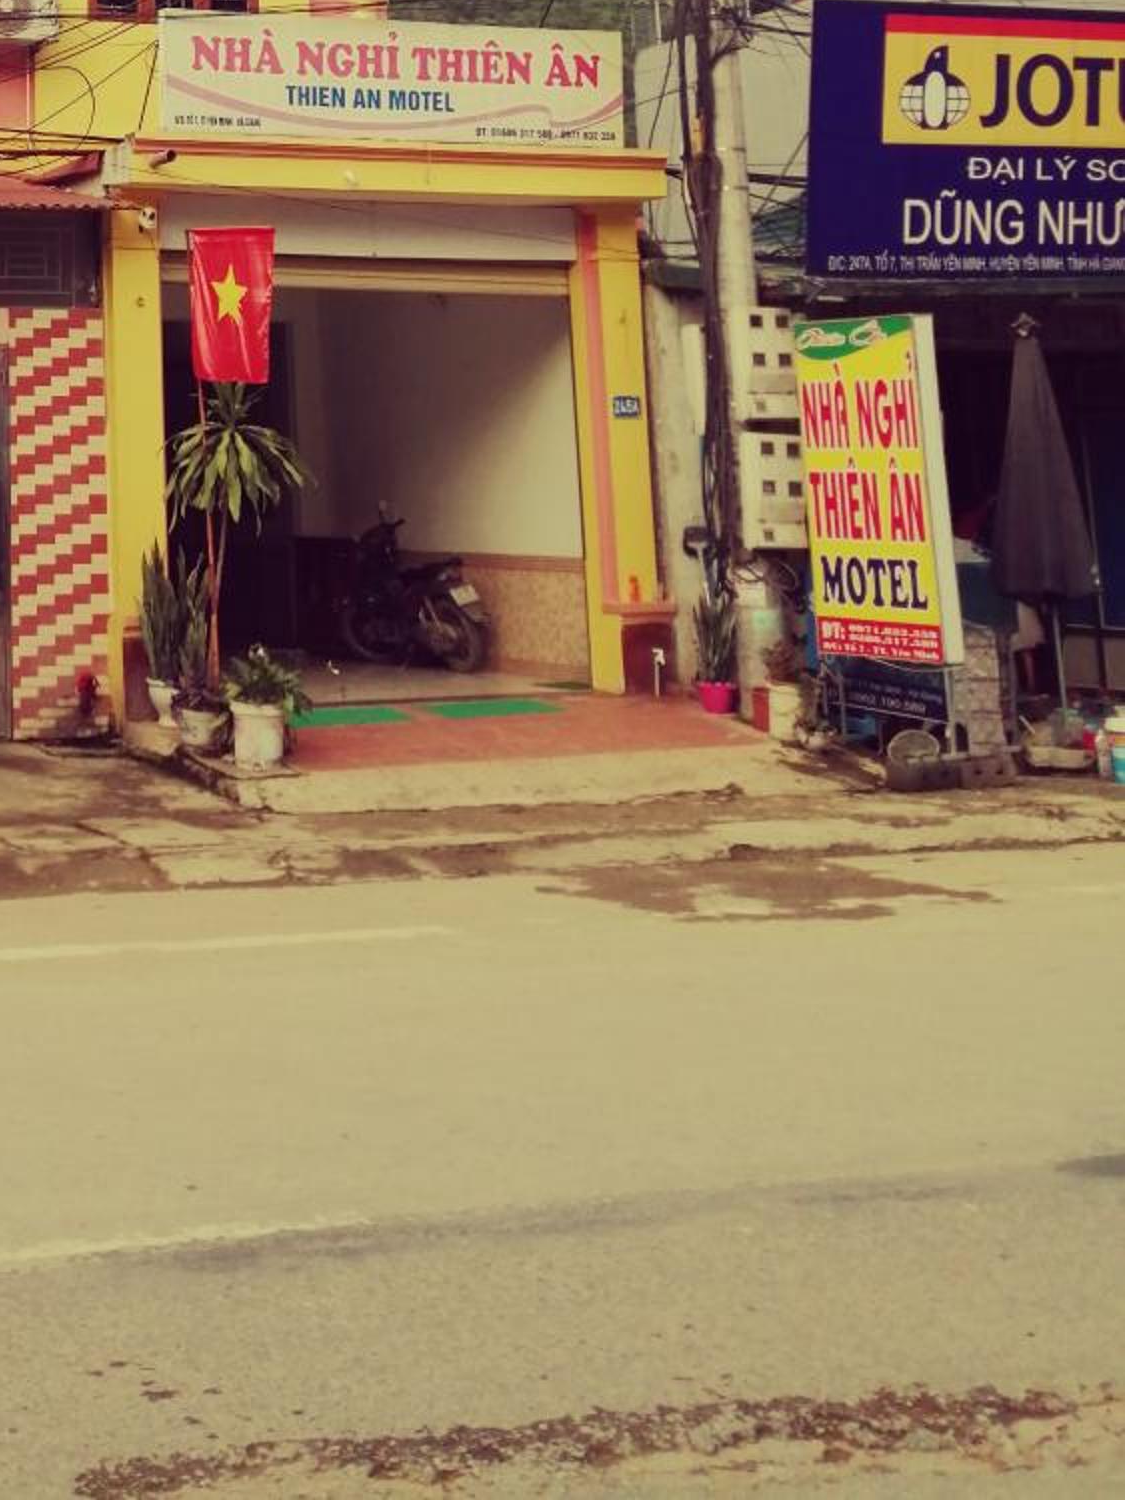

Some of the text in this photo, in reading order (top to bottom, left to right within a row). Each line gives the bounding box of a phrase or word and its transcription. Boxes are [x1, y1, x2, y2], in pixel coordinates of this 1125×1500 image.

[191, 28, 600, 88] NHÀ NGHỈ THIÊN ÂN
[285, 85, 455, 112] THIEN AN MOTEL
[967, 157, 1024, 185] ĐẠI
[1036, 155, 1077, 181] LÝ
[903, 189, 1024, 245] DŨNG
[802, 351, 918, 449] NHÀ NGHỈ
[809, 457, 925, 543] THIÊN ÂN
[820, 555, 928, 610] MOTEL
